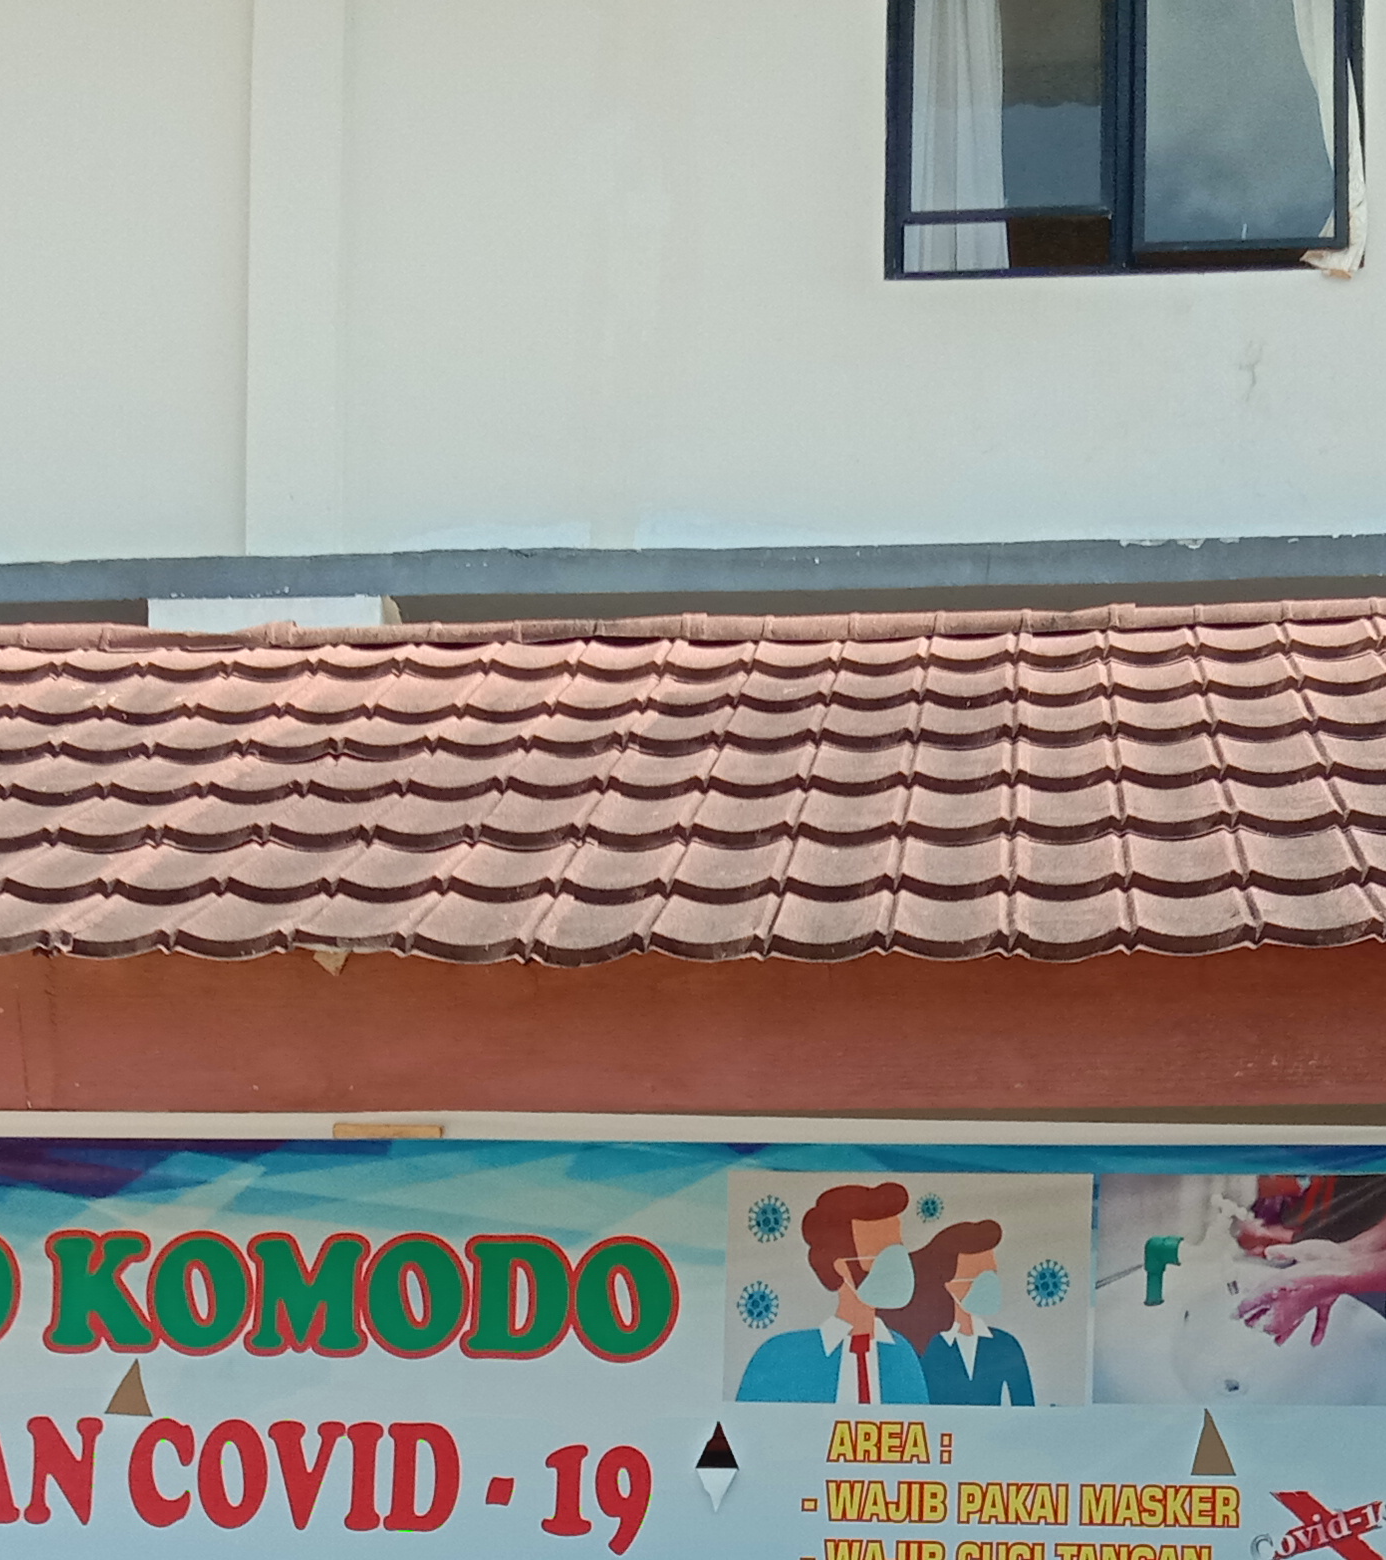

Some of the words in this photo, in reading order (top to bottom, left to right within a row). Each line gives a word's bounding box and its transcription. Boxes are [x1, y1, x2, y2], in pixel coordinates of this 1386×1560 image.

[43, 1231, 679, 1363] KOMODO
[128, 1418, 461, 1532] COVID
[541, 1445, 652, 1555] 19
[827, 1421, 931, 1464] AREA
[826, 1481, 948, 1525] WAJIB
[958, 1483, 1068, 1526] PAKAI
[1080, 1486, 1239, 1528] MASKER
